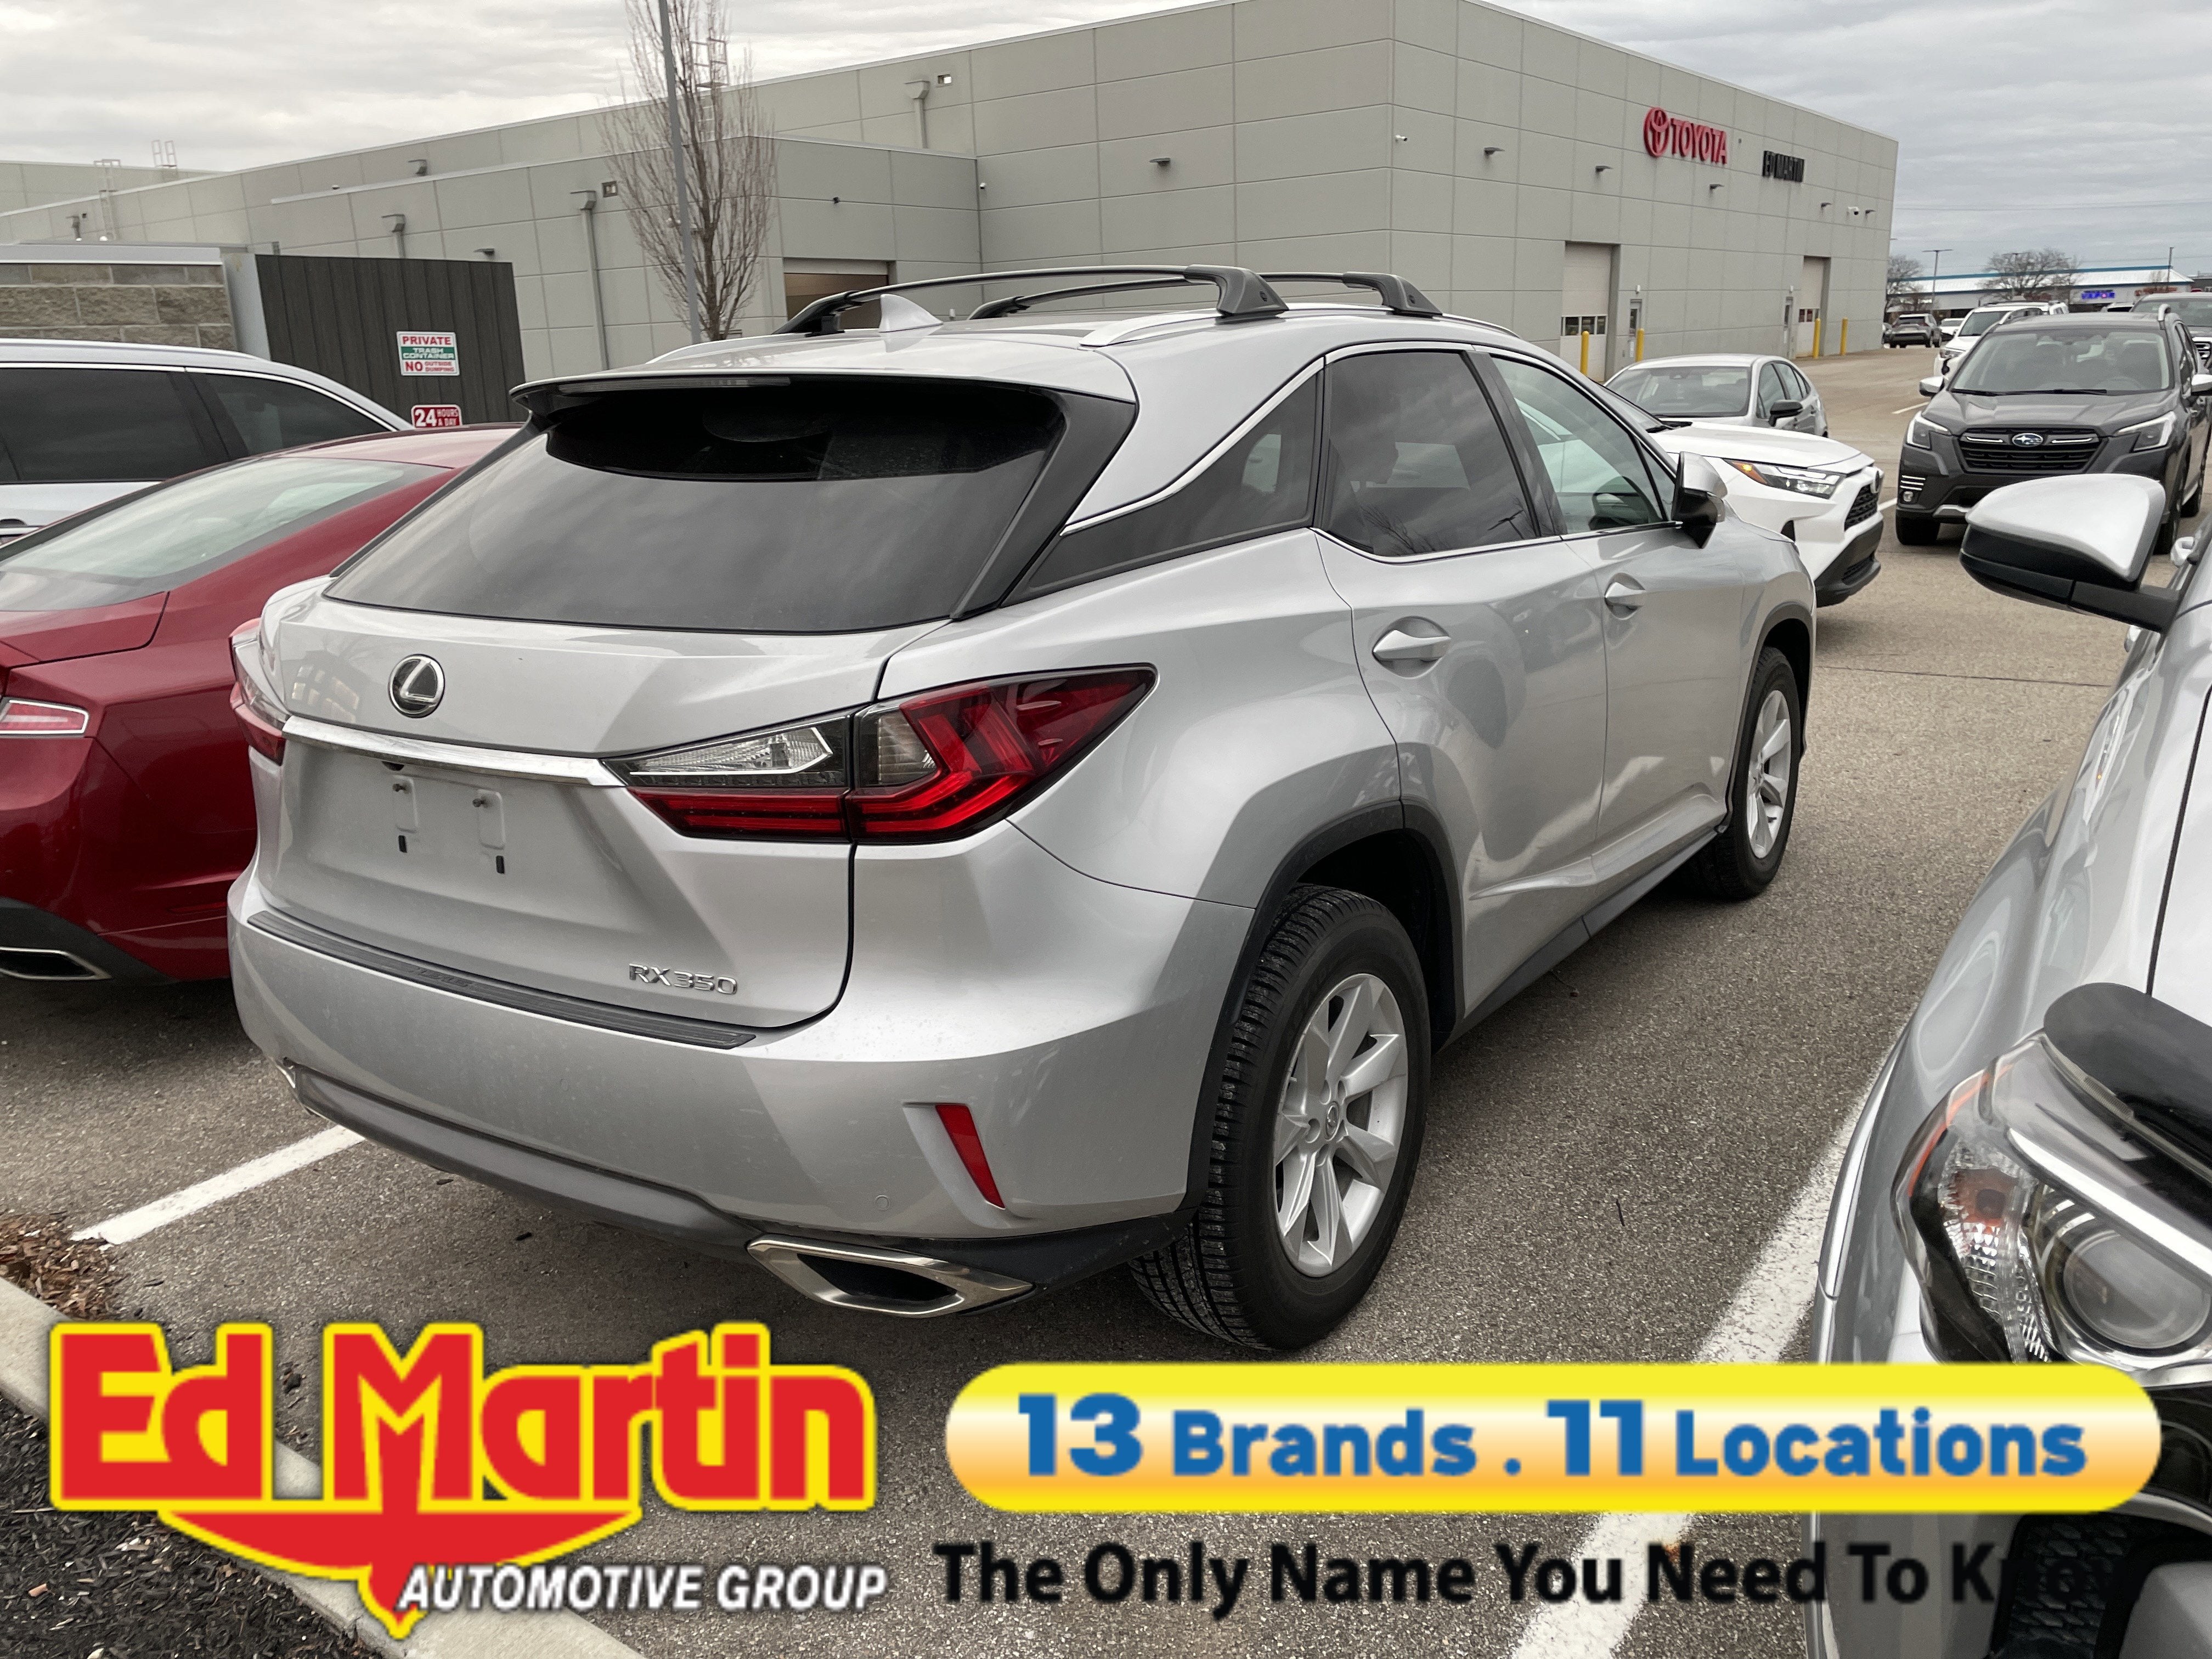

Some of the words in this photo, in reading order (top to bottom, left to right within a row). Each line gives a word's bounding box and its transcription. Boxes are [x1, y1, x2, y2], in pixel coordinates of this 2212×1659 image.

[1670, 118, 1727, 165] TOYOTA
[402, 336, 452, 345] PRIVATE
[405, 362, 423, 371] NO
[414, 409, 437, 427] 24
[437, 409, 459, 417] HOURS
[438, 418, 443, 426] A
